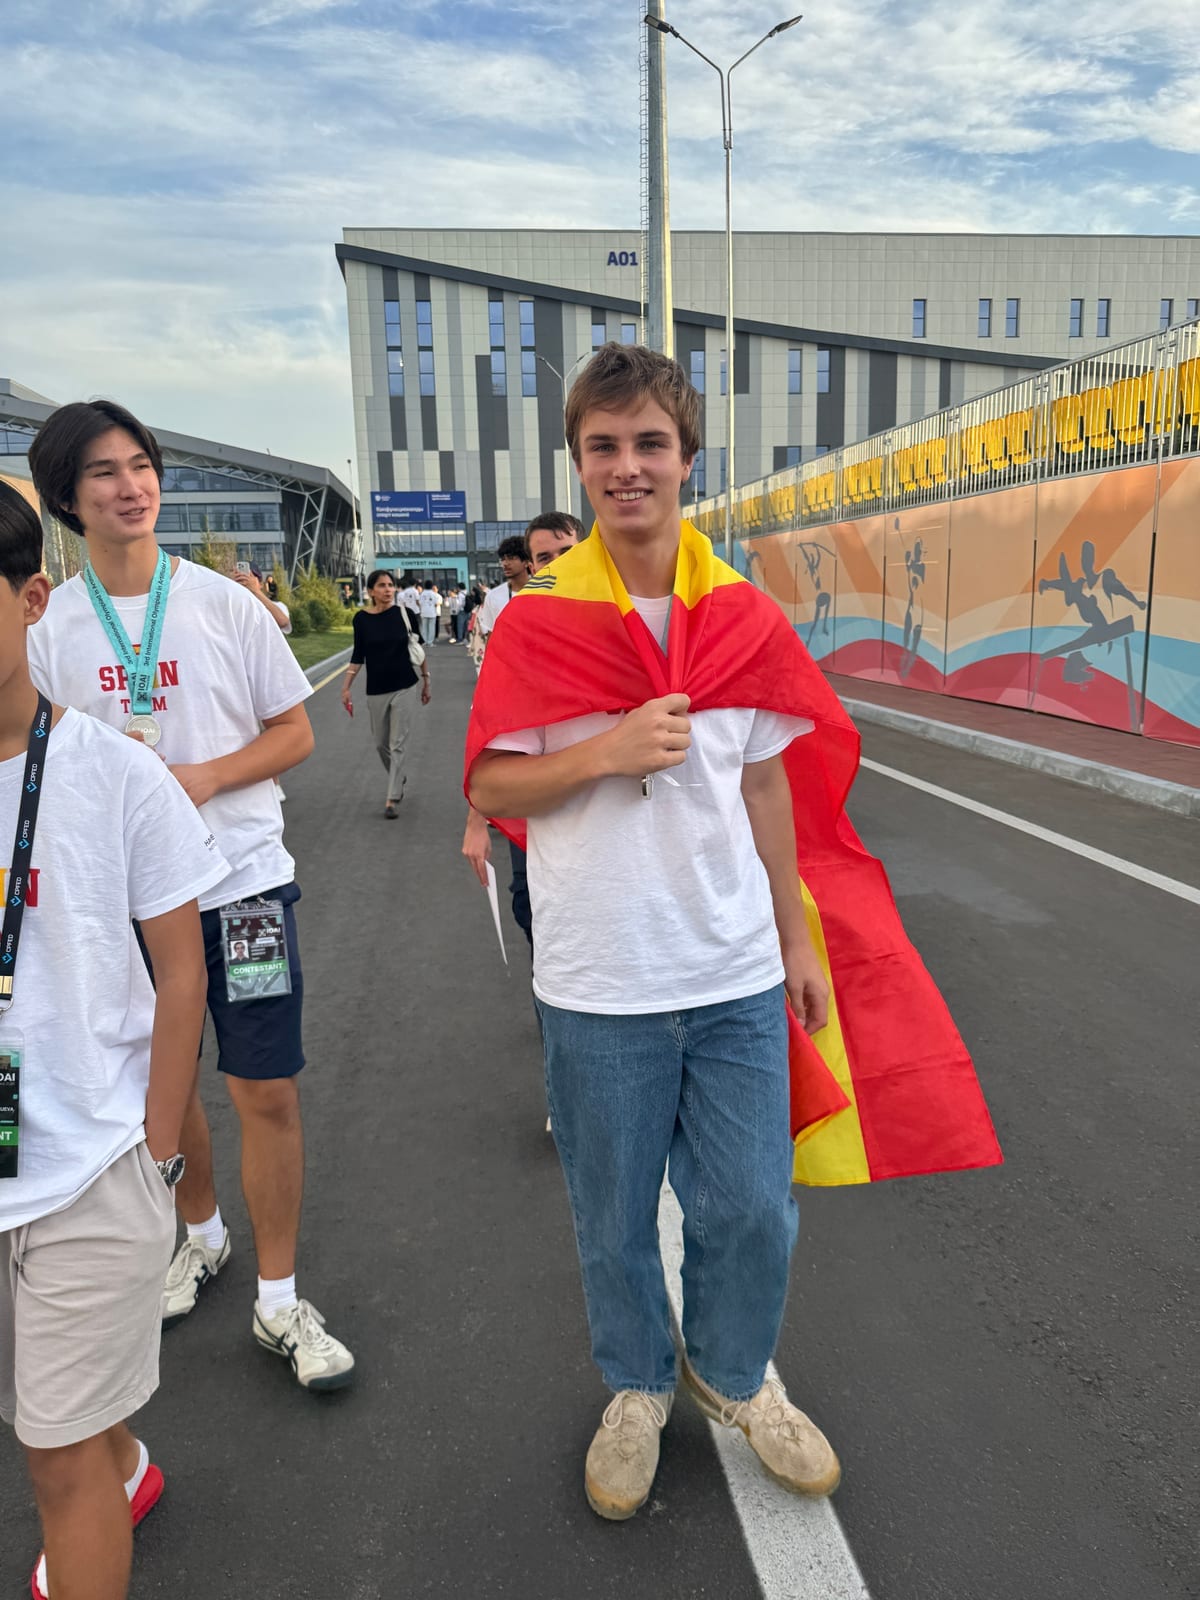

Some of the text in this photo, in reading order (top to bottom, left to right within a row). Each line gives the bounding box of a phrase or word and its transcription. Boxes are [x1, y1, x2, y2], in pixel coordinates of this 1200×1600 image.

[607, 251, 638, 266] A01
[151, 590, 162, 619] Olympiad
[146, 619, 157, 656] International
[98, 660, 179, 692] SPN
[138, 674, 147, 691] IOAI
[120, 696, 168, 714] TM
[39, 711, 48, 729] CPFED
[30, 763, 38, 782] CPFED
[22, 819, 30, 838] CPFED
[14, 876, 22, 896] CPFED
[6, 934, 14, 953] CPFED
[233, 962, 284, 975] CONTESTANT
